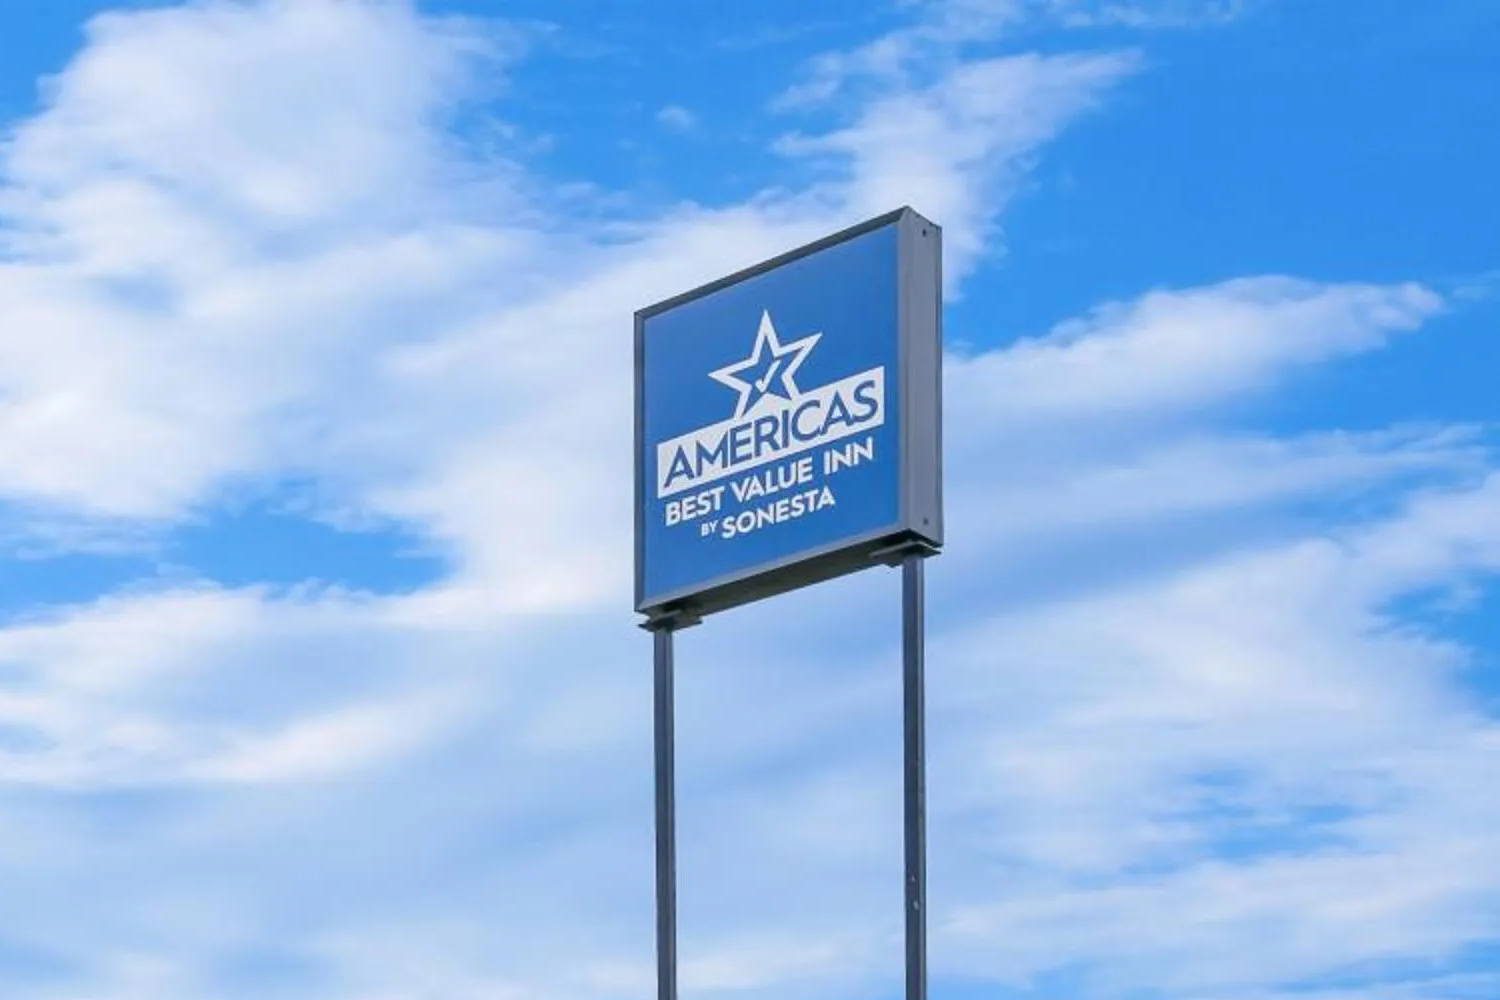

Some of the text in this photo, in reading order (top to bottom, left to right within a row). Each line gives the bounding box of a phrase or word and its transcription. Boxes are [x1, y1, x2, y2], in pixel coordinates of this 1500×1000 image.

[663, 380, 879, 488] AMERICAS
[665, 437, 874, 527] BEST VALUE INN
[701, 486, 836, 539] BY SONESTA
